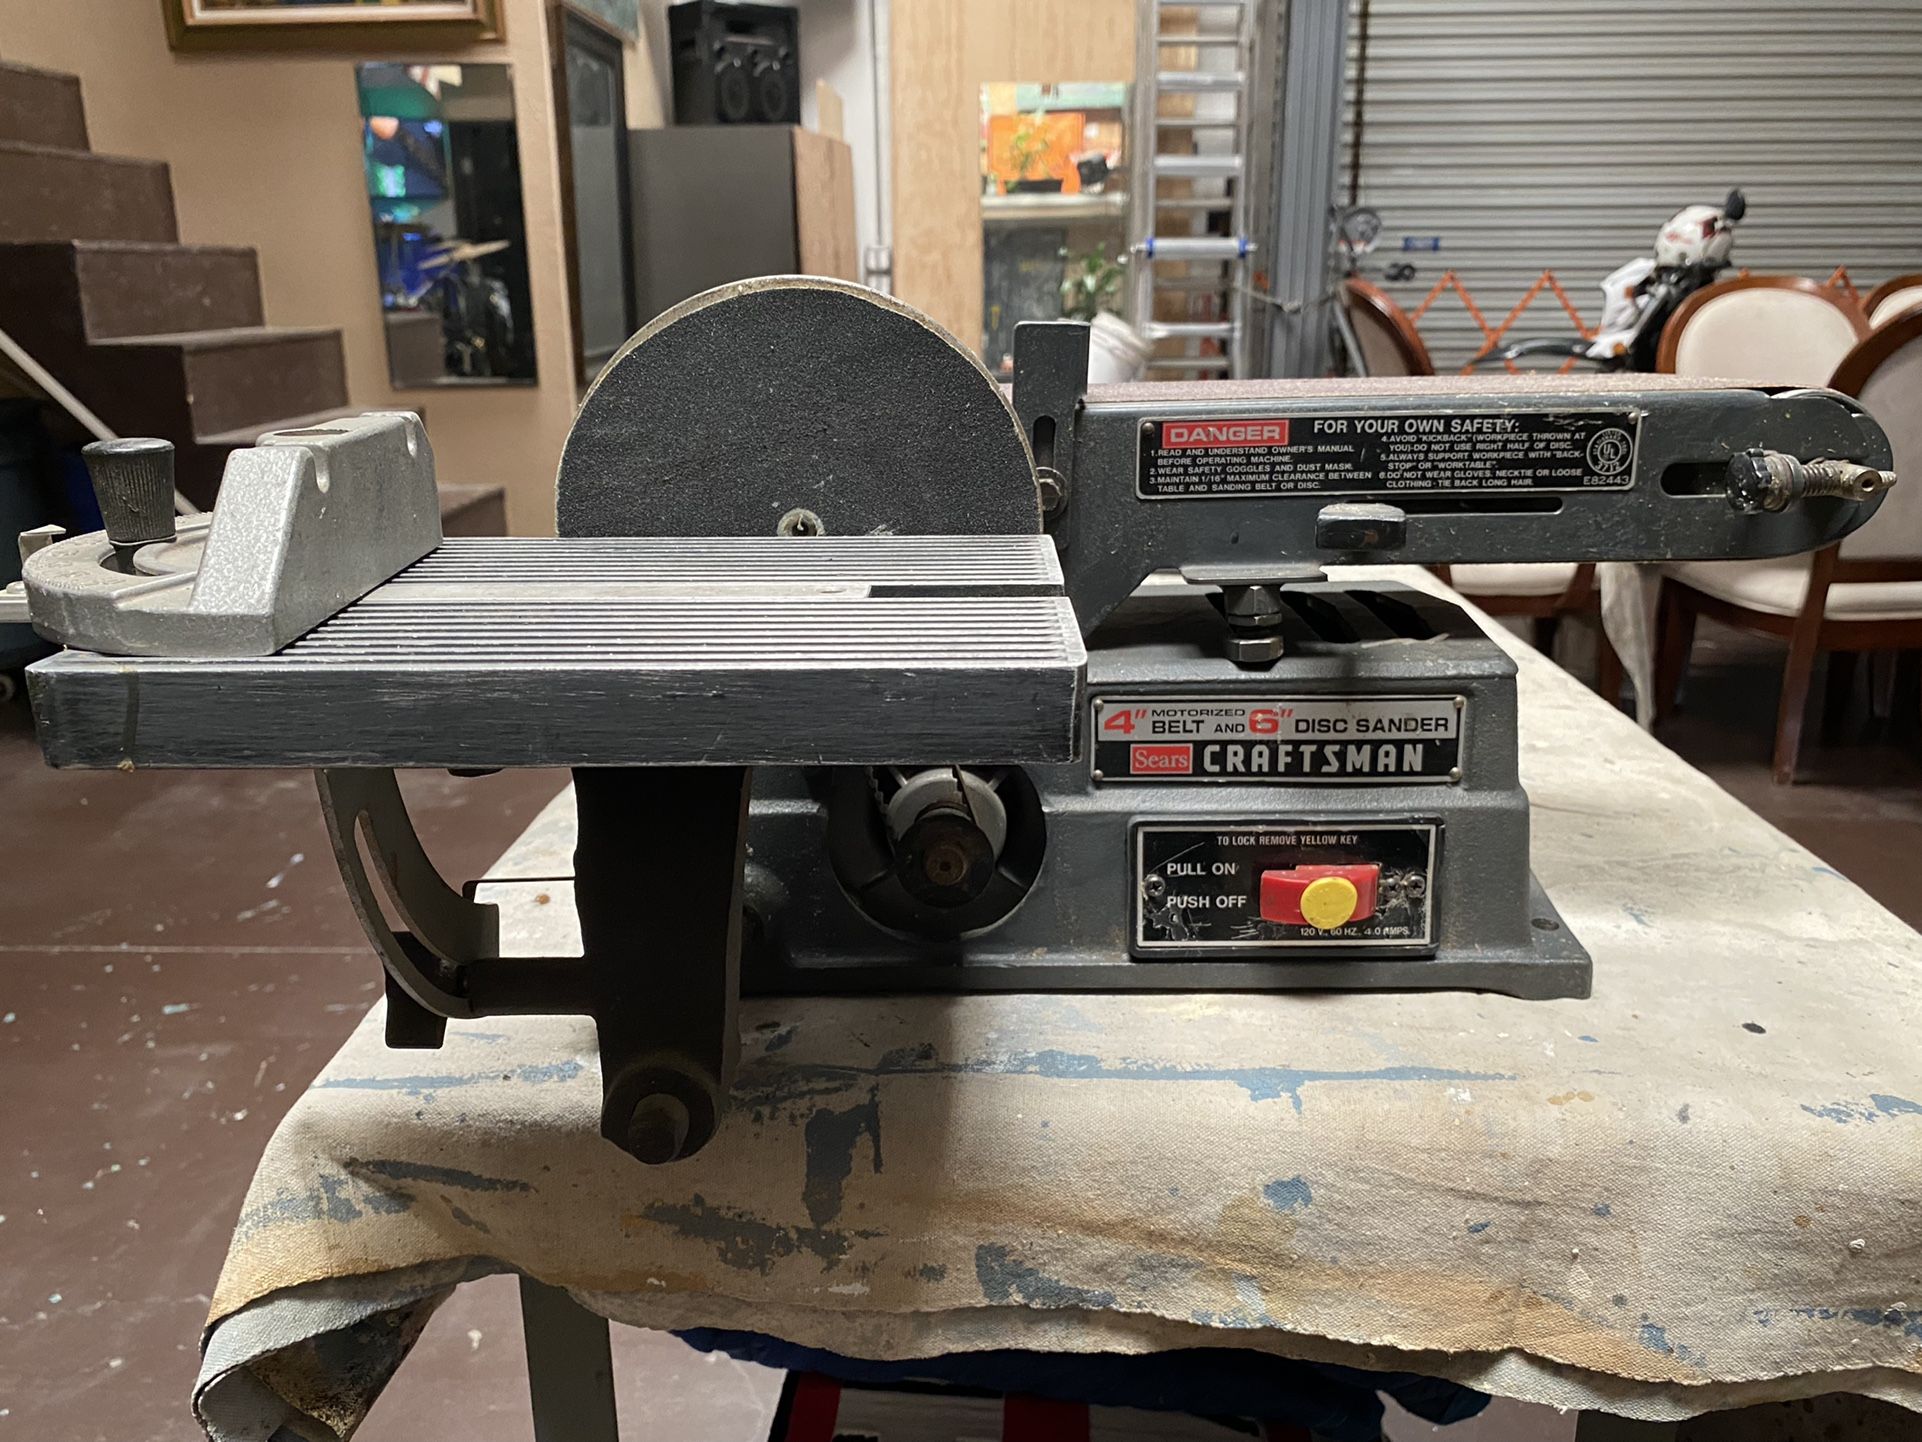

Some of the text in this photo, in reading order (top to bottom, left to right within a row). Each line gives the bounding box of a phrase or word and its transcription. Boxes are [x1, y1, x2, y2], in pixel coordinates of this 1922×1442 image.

[1313, 418, 1520, 434] FOR YOUR OWN SAFETY:
[1170, 425, 1280, 443] DANGER
[1419, 433, 1472, 442] "KICKBACK"
[1472, 432, 1529, 442] (WORKPIECE
[1532, 432, 1571, 440] THROWN
[1573, 431, 1586, 440] AT
[1186, 448, 1204, 456] AND
[1208, 446, 1268, 455] UNDERSTAND
[1271, 445, 1313, 453] OWNER'S
[1317, 444, 1355, 453] MANUAL
[1430, 443, 1450, 451] NOT
[1453, 443, 1472, 451] USE
[1475, 442, 1504, 450] RIGHT
[1506, 441, 1531, 450] HALF
[1533, 441, 1547, 450] OF
[1549, 441, 1573, 449] DISC.
[1603, 443, 1616, 459] UL
[1157, 455, 1293, 466] BEFORE OPERATING MACHINE.
[1427, 451, 1469, 460] SUPPORT
[1472, 450, 1525, 459] WORKPIECE
[1528, 450, 1552, 459] WITH
[1187, 466, 1222, 474] SAFETY
[1226, 464, 1271, 473] GOGGLES
[1274, 464, 1294, 472] AND
[1297, 463, 1322, 471] DUST
[1324, 462, 1353, 471] MASK.
[1387, 461, 1417, 470] STOP"
[1418, 461, 1432, 469] OR
[1201, 474, 1225, 482] 1/16"
[1226, 473, 1269, 482] MAXIMUM
[1271, 472, 1325, 481] CLEARANCE
[1328, 471, 1372, 480] BETWEEN
[1403, 470, 1422, 479] NOT
[1425, 470, 1452, 478] WEAR
[1495, 468, 1534, 477] NECKTIE
[1536, 468, 1550, 477] OR
[1551, 468, 1583, 476] LOOSE
[1454, 479, 1479, 487] BACK
[1482, 478, 1508, 487] LONG
[1510, 477, 1534, 486] HAIR.
[1583, 475, 1629, 485] E82443
[1158, 481, 1321, 493] TABLE AND SANDING BELT OR DISC.
[1151, 708, 1246, 717] MOTORIZED
[1103, 708, 1449, 735] 4" BELT AND 6" DISC SANDER
[1135, 743, 1423, 773] Sears CRAFTSMAN
[1216, 835, 1358, 846] TO LOCK REMOVE YELLOW KEY
[1166, 862, 1236, 875] PULL ON
[1166, 895, 1247, 909] PUSH OFF
[1300, 928, 1316, 936] 120
[1330, 928, 1342, 936] 60
